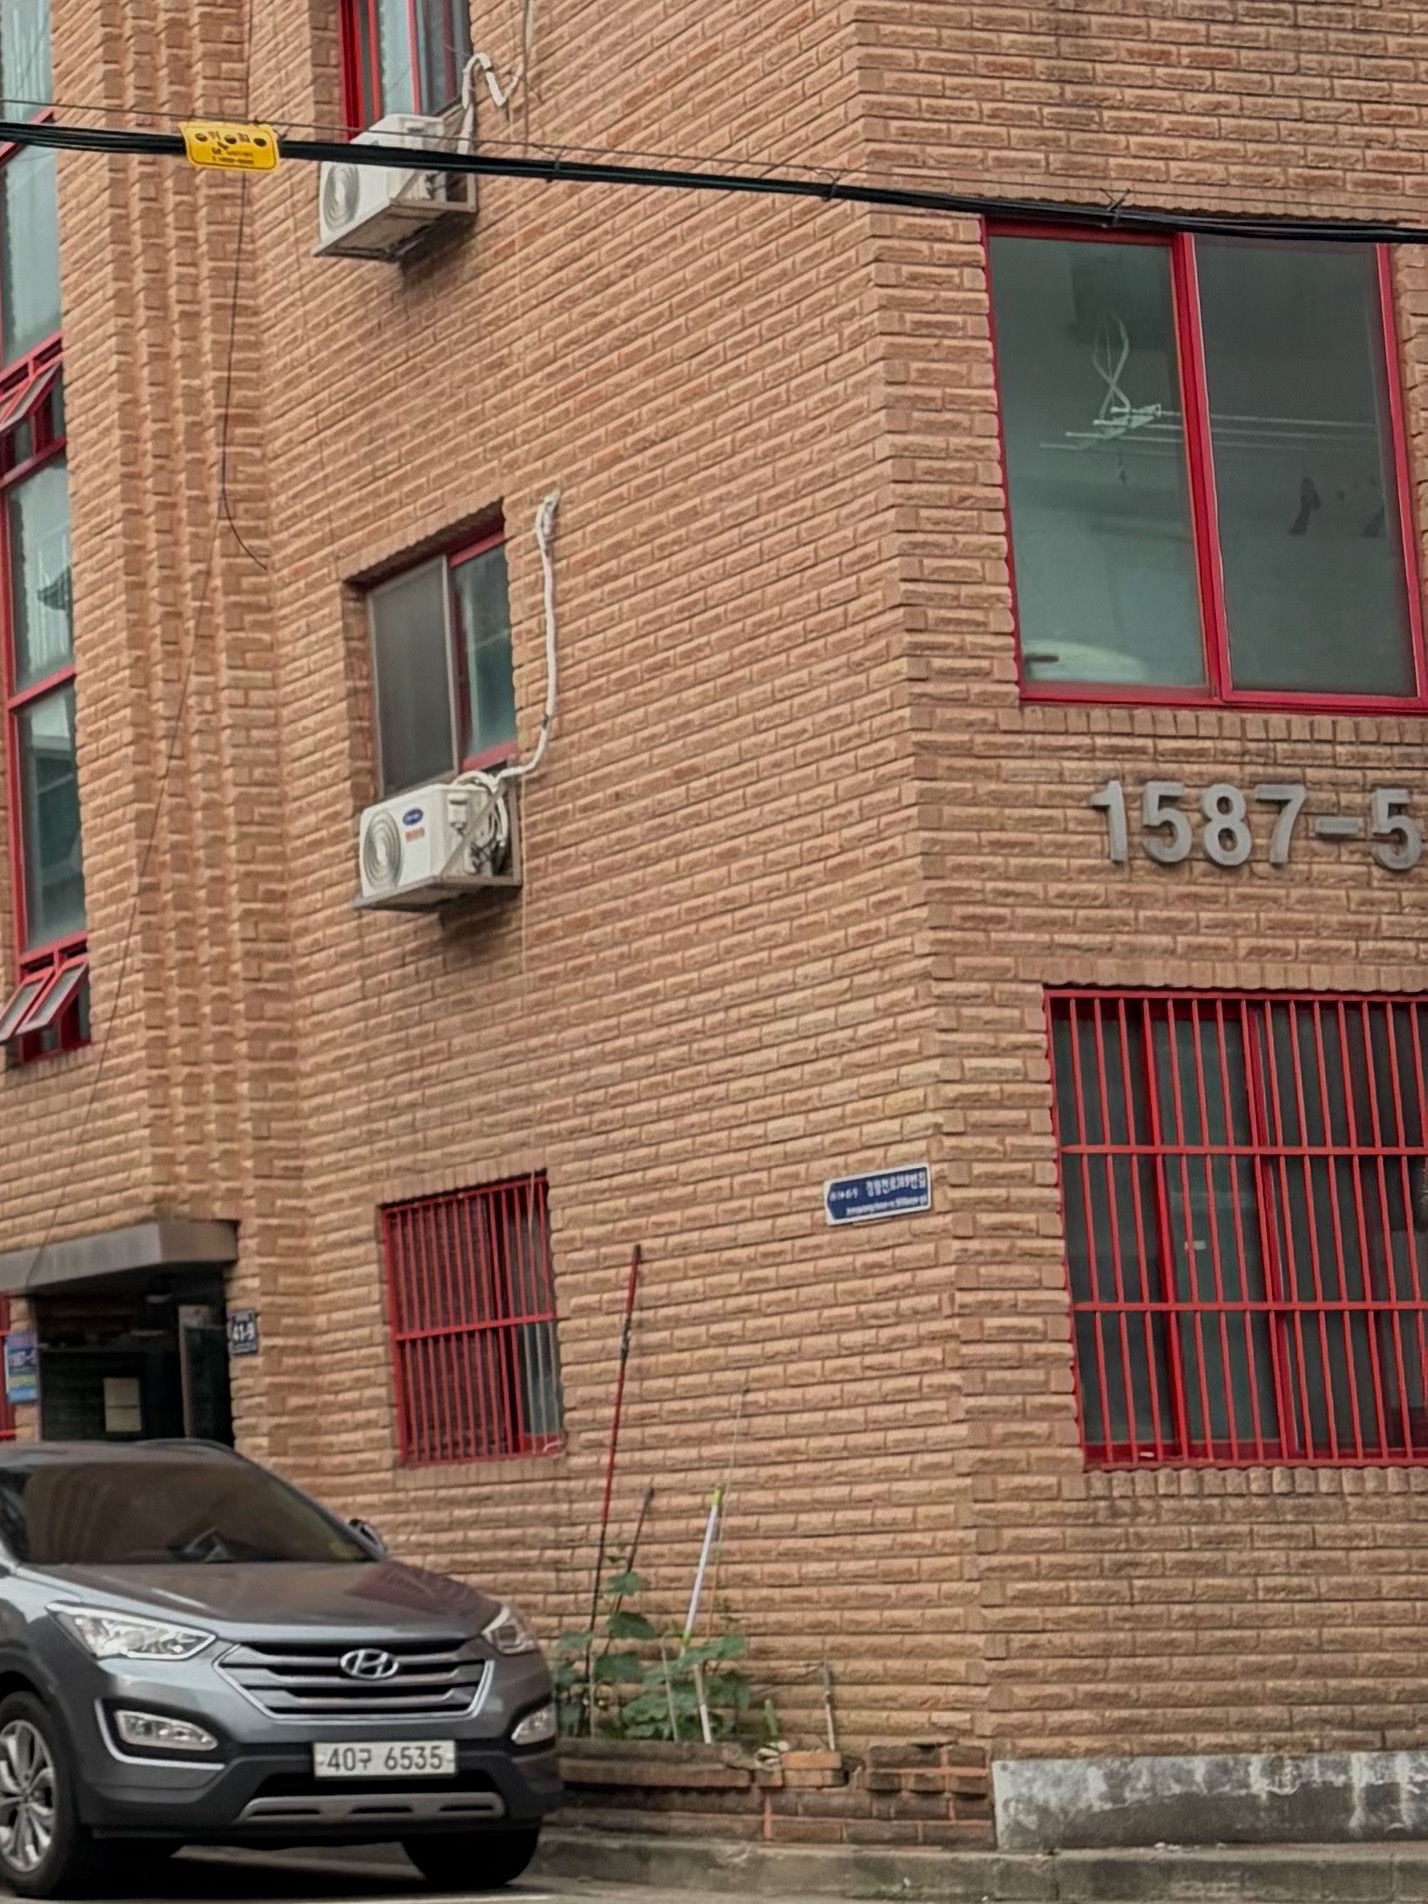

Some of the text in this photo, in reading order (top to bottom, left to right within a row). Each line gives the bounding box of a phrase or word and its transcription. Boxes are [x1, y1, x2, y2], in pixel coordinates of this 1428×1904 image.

[1089, 780, 1422, 871] 1587-5
[327, 1745, 443, 1772] 40구 6535
